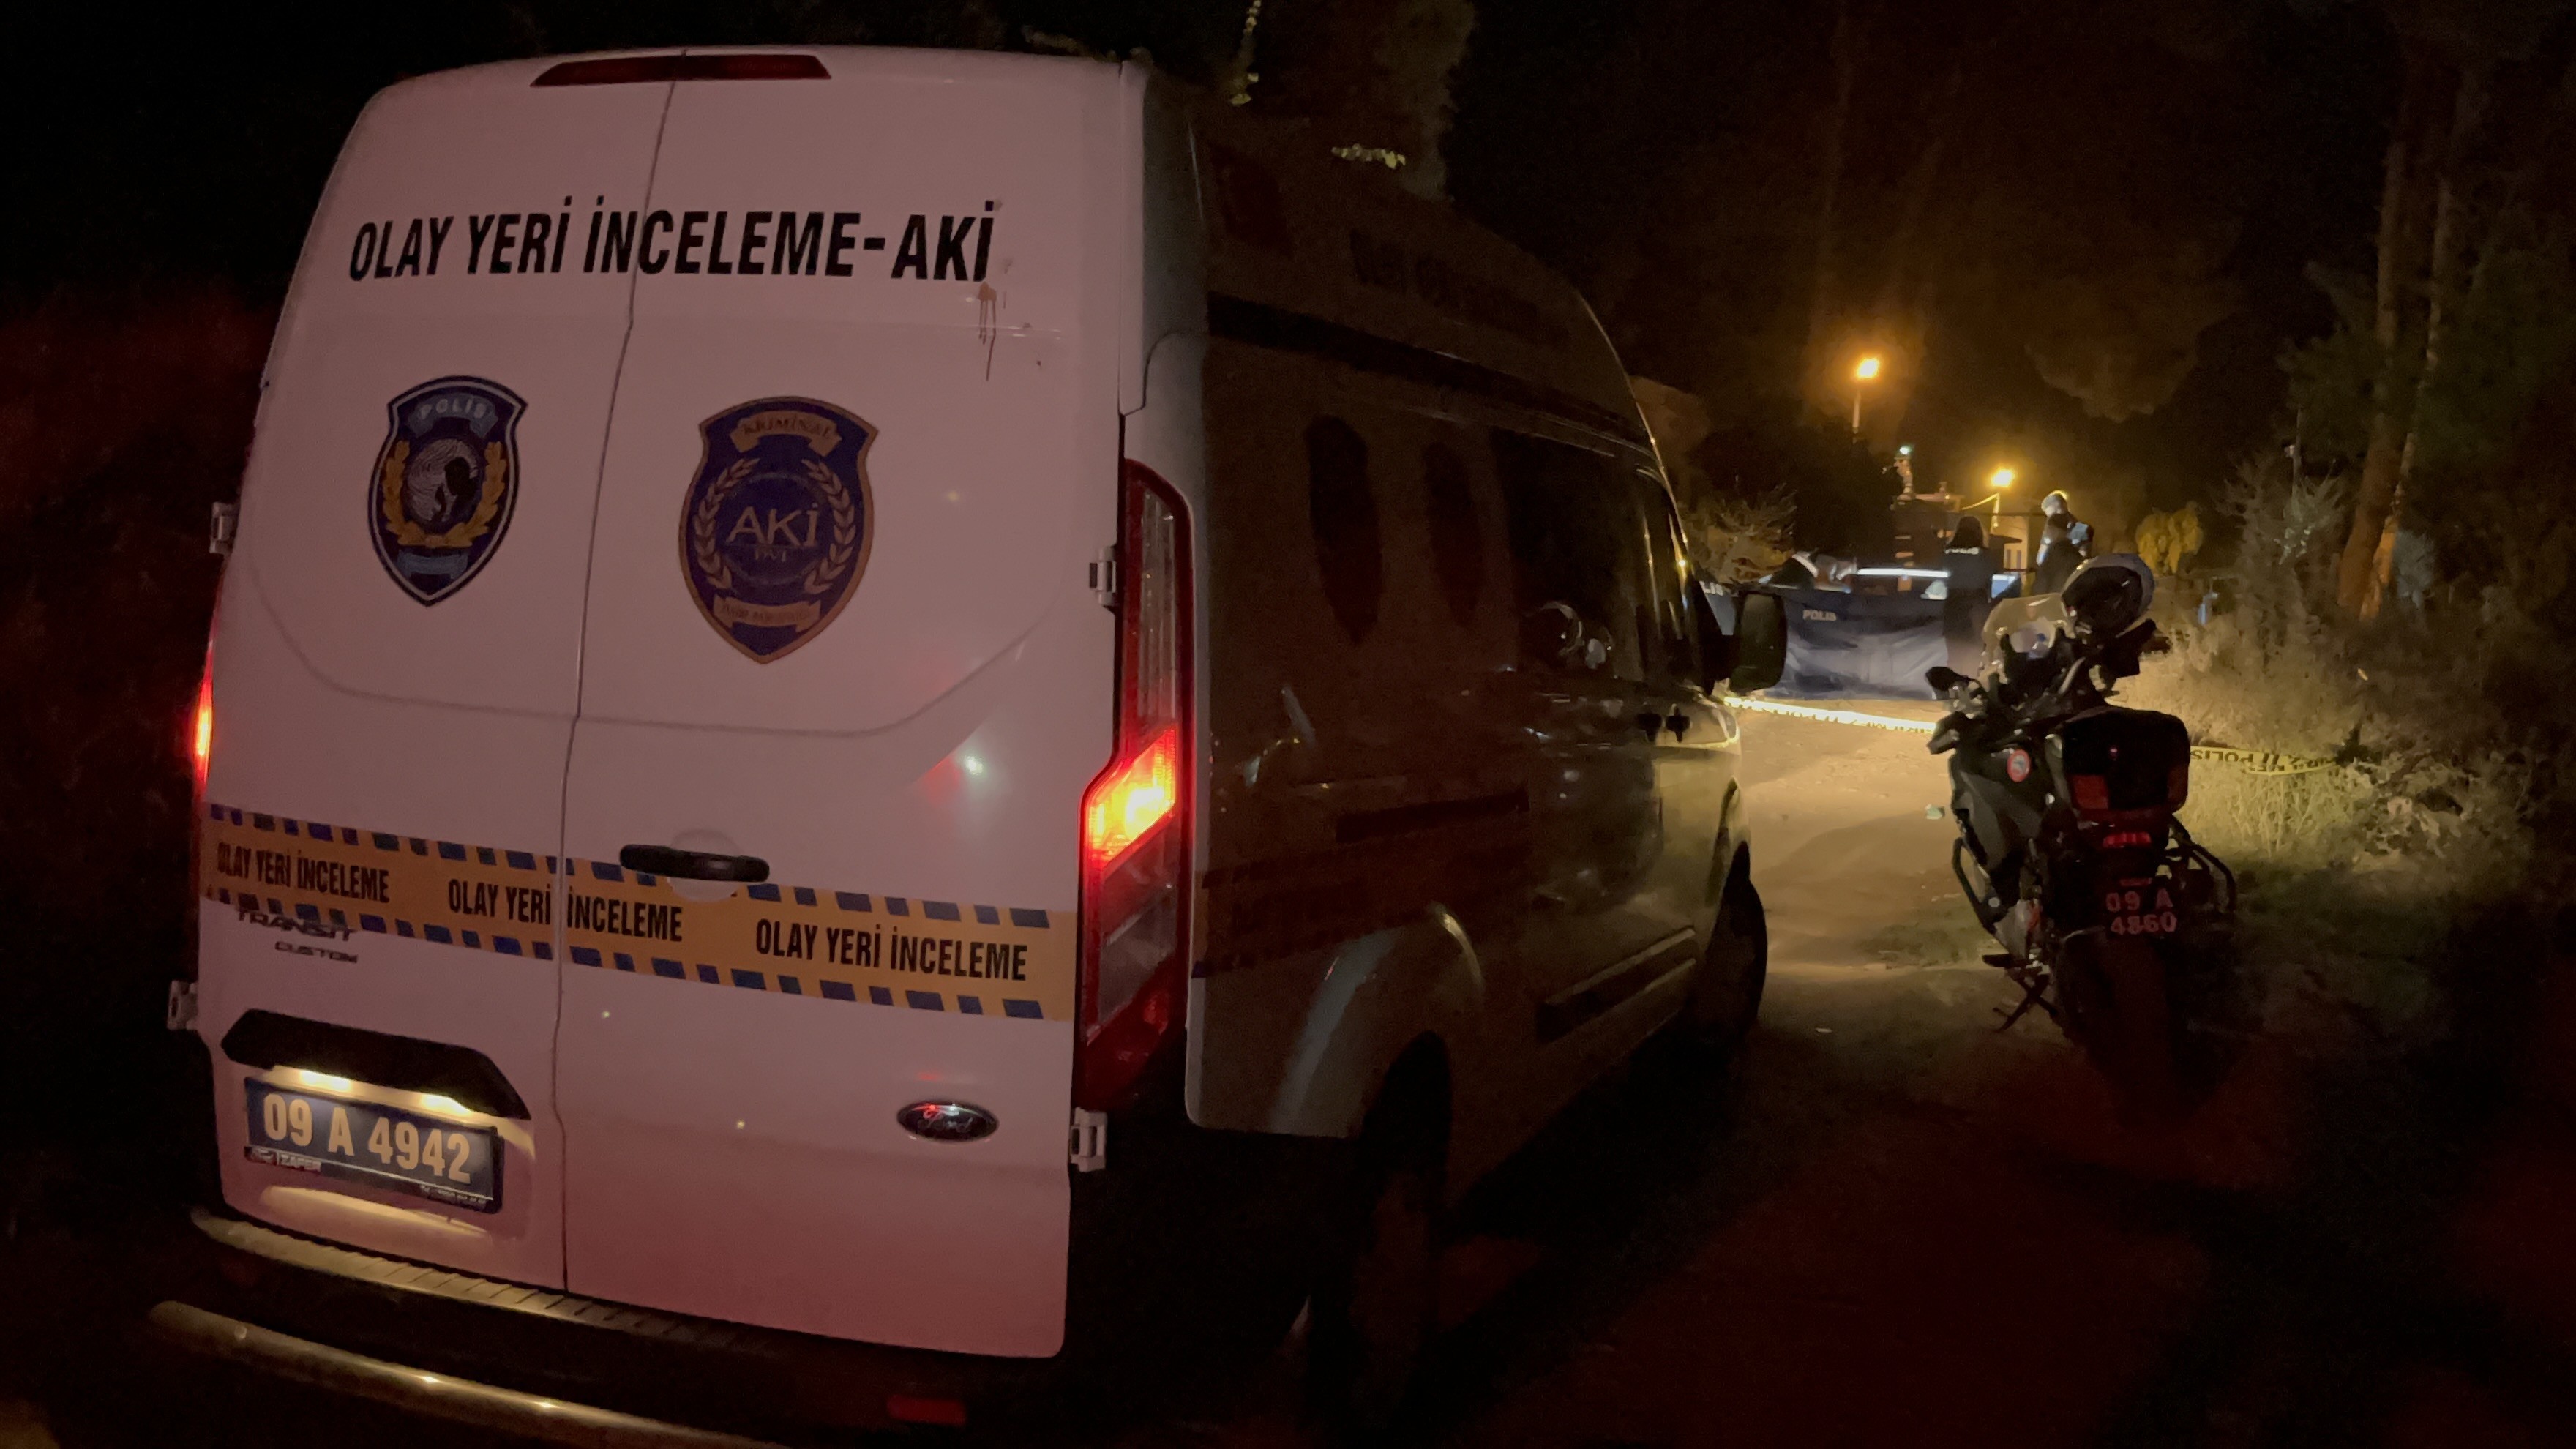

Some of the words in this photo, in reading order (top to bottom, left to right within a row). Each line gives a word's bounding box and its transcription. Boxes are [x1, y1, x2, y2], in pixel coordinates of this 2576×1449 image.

[350, 217, 454, 281] OLAY
[465, 195, 573, 274] YERİ
[583, 195, 995, 281] İNCELEME-AKİ
[725, 502, 820, 547] AKİ
[217, 842, 252, 878] OLAY
[256, 849, 291, 887] YERİ
[296, 849, 390, 903] İNCELEME
[2106, 890, 2141, 913] 09
[2155, 888, 2174, 909] A
[447, 879, 498, 918] OLAY
[506, 883, 552, 925] YERİ
[566, 886, 683, 942] İNCELEME
[2111, 911, 2178, 935] 4860
[755, 918, 818, 960] OLAY
[826, 924, 882, 967] YERİ
[890, 926, 1028, 981] İNCELEME
[263, 1092, 313, 1147] 09
[328, 1107, 355, 1156] A
[368, 1117, 472, 1184] 4942
